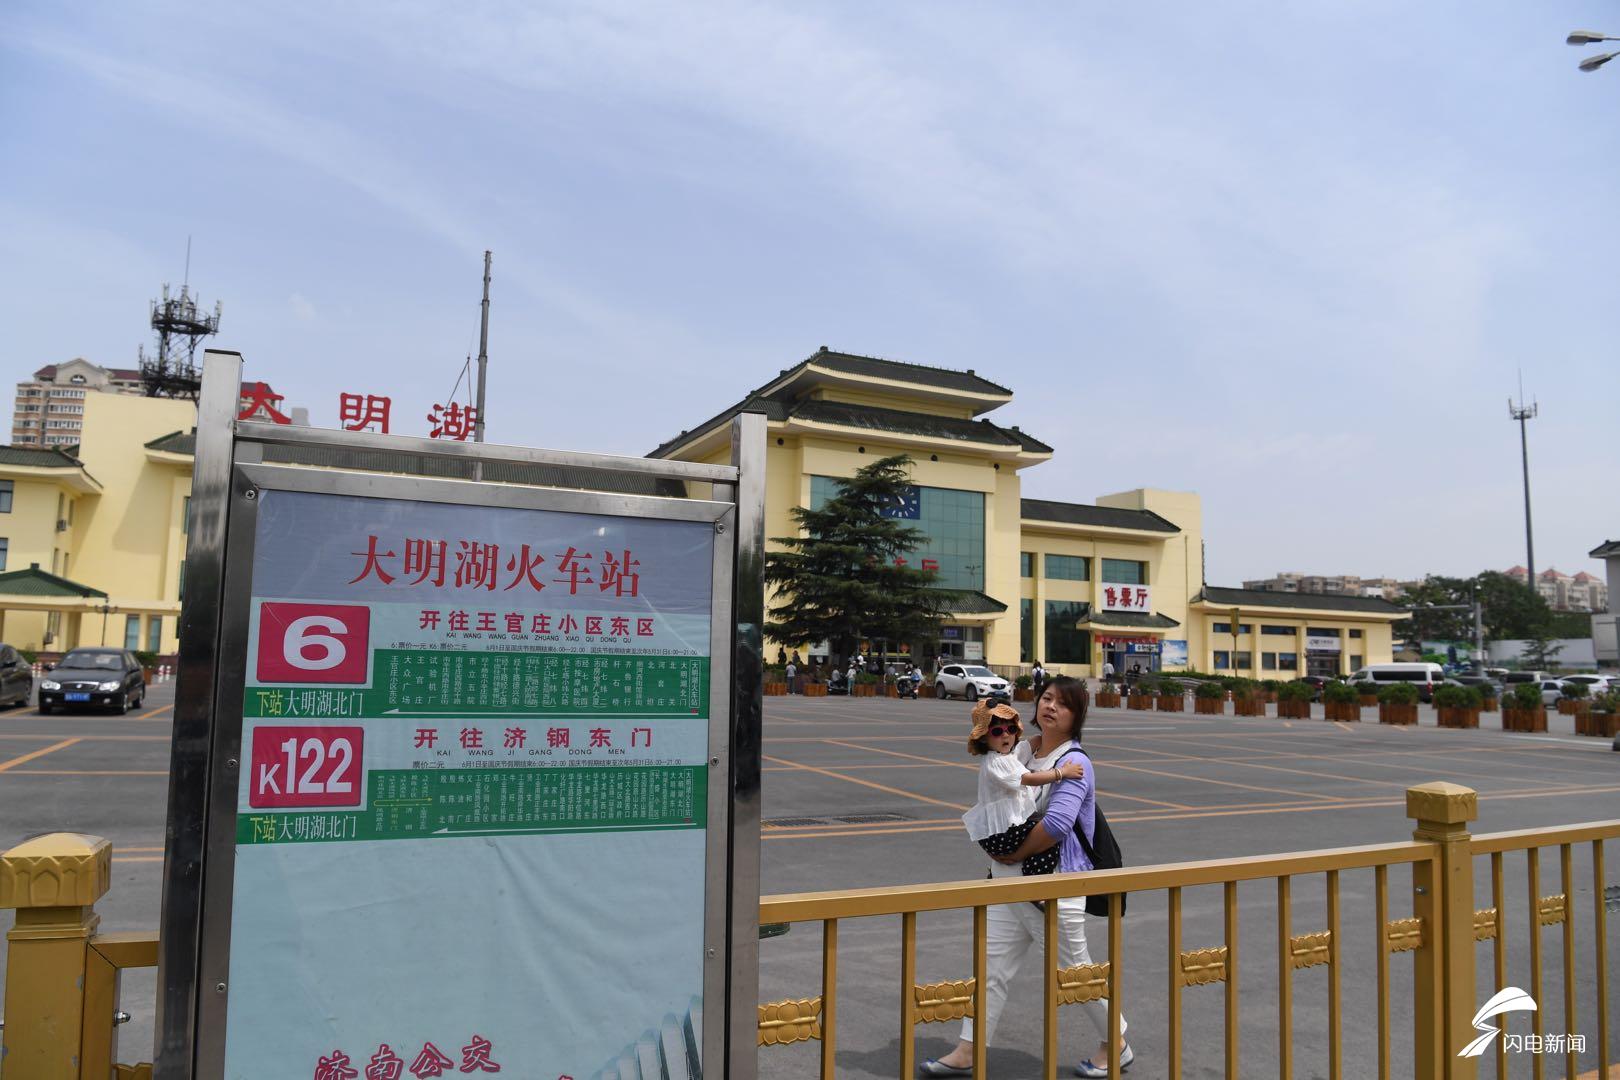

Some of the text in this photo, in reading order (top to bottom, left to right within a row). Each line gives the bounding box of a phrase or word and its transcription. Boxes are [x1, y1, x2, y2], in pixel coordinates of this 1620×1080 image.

[349, 535, 641, 598] 大明湖火车站
[1105, 587, 1147, 608] 售票厅
[283, 615, 348, 671] 6
[419, 610, 654, 636] 开往王官庄小区东区
[402, 655, 412, 705] 大众广场
[415, 656, 425, 704] 王官庄
[414, 727, 652, 749] 开往济钢东门
[259, 738, 353, 794] K122
